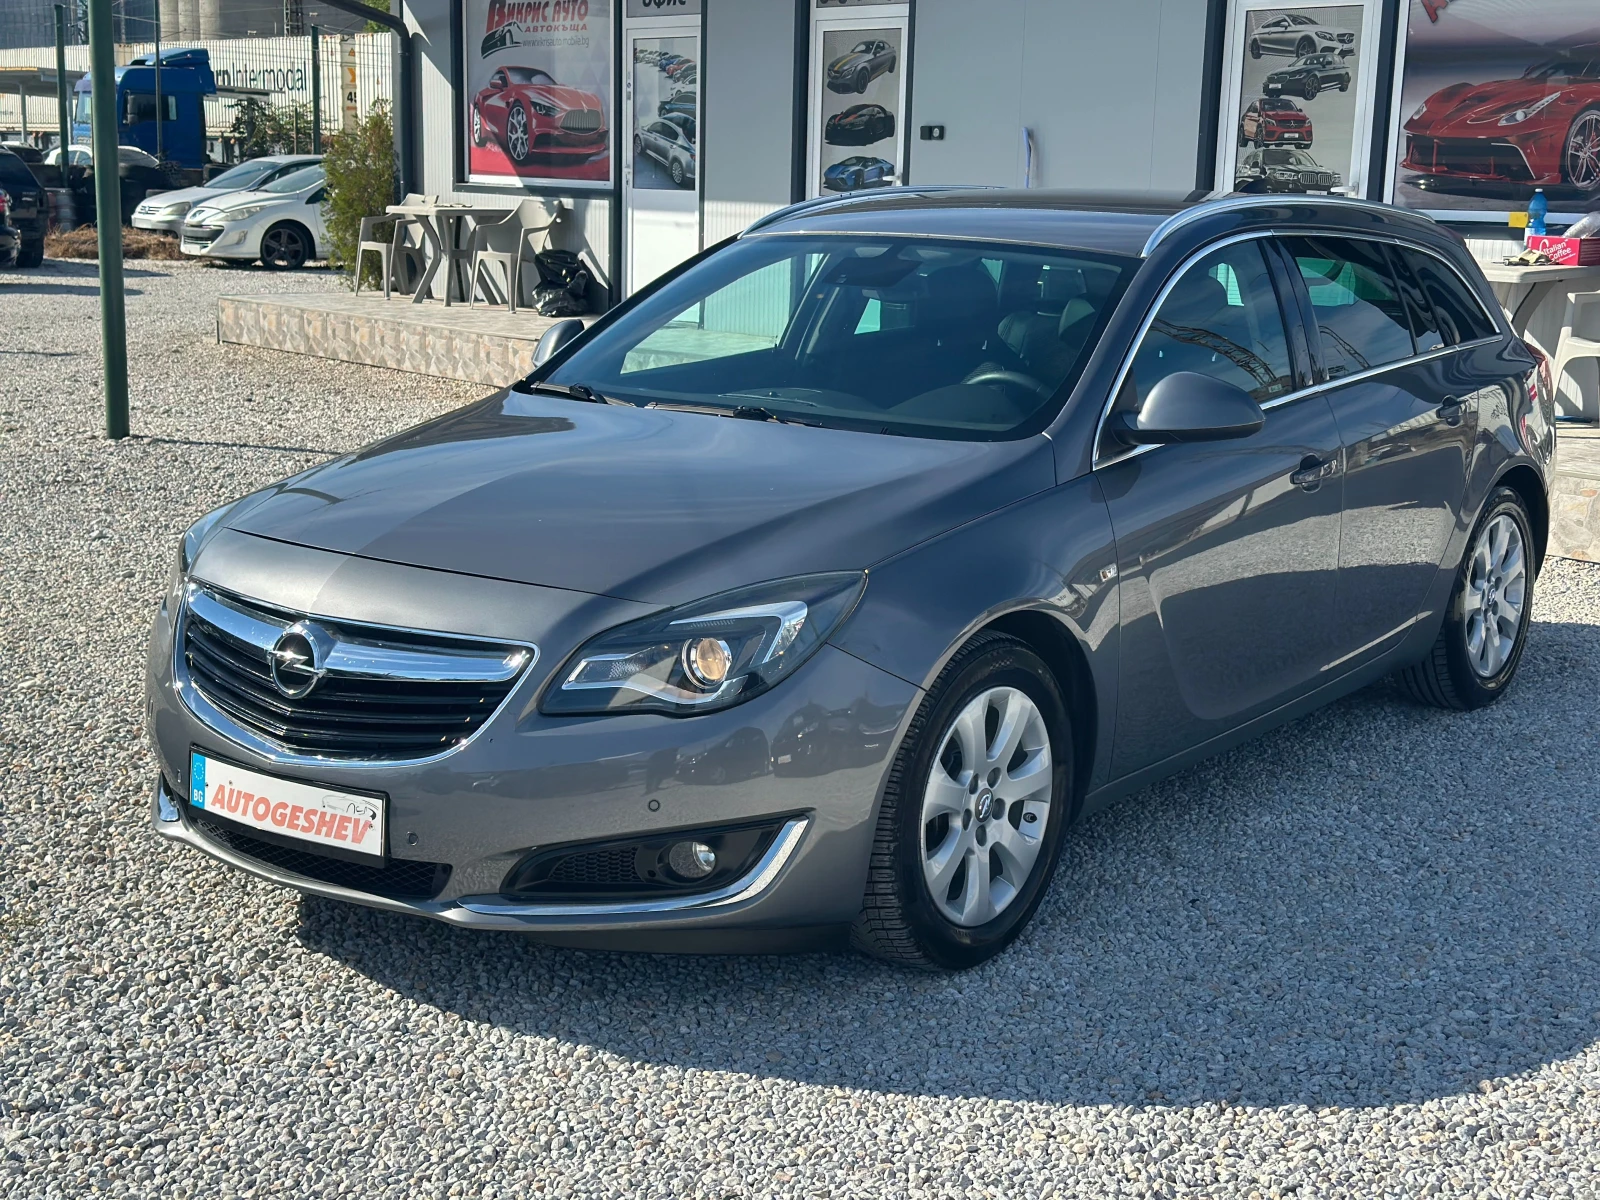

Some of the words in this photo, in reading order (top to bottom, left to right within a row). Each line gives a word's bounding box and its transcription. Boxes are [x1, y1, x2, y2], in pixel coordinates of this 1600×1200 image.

[524, 23, 588, 33] АВТОКЪЩА
[1543, 241, 1567, 256] Italian
[1548, 247, 1572, 261] Coffee
[193, 788, 204, 803] BG
[211, 784, 371, 845] AUTOGESHEV
